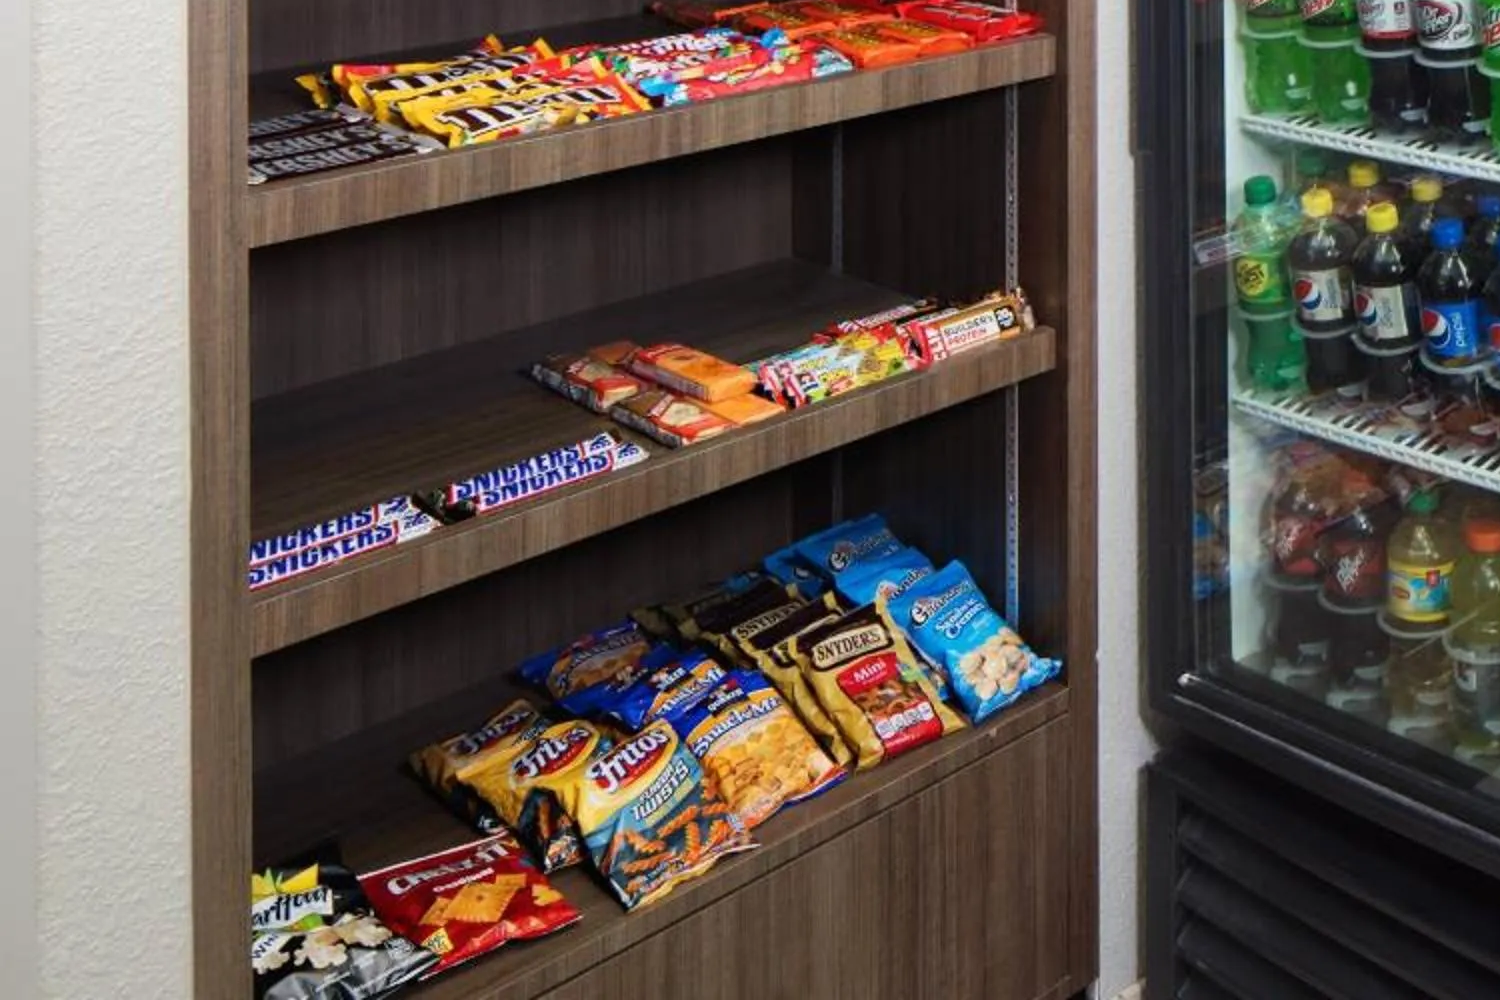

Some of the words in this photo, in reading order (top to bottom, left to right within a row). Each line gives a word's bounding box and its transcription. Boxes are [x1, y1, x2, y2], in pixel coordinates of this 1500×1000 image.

[456, 443, 582, 500] SNICKERS
[482, 451, 610, 507] SNICKERS
[249, 521, 394, 585] SNICKERS
[250, 505, 374, 563] NICKERS
[853, 659, 886, 682] Mini
[586, 728, 670, 794] Fritos
